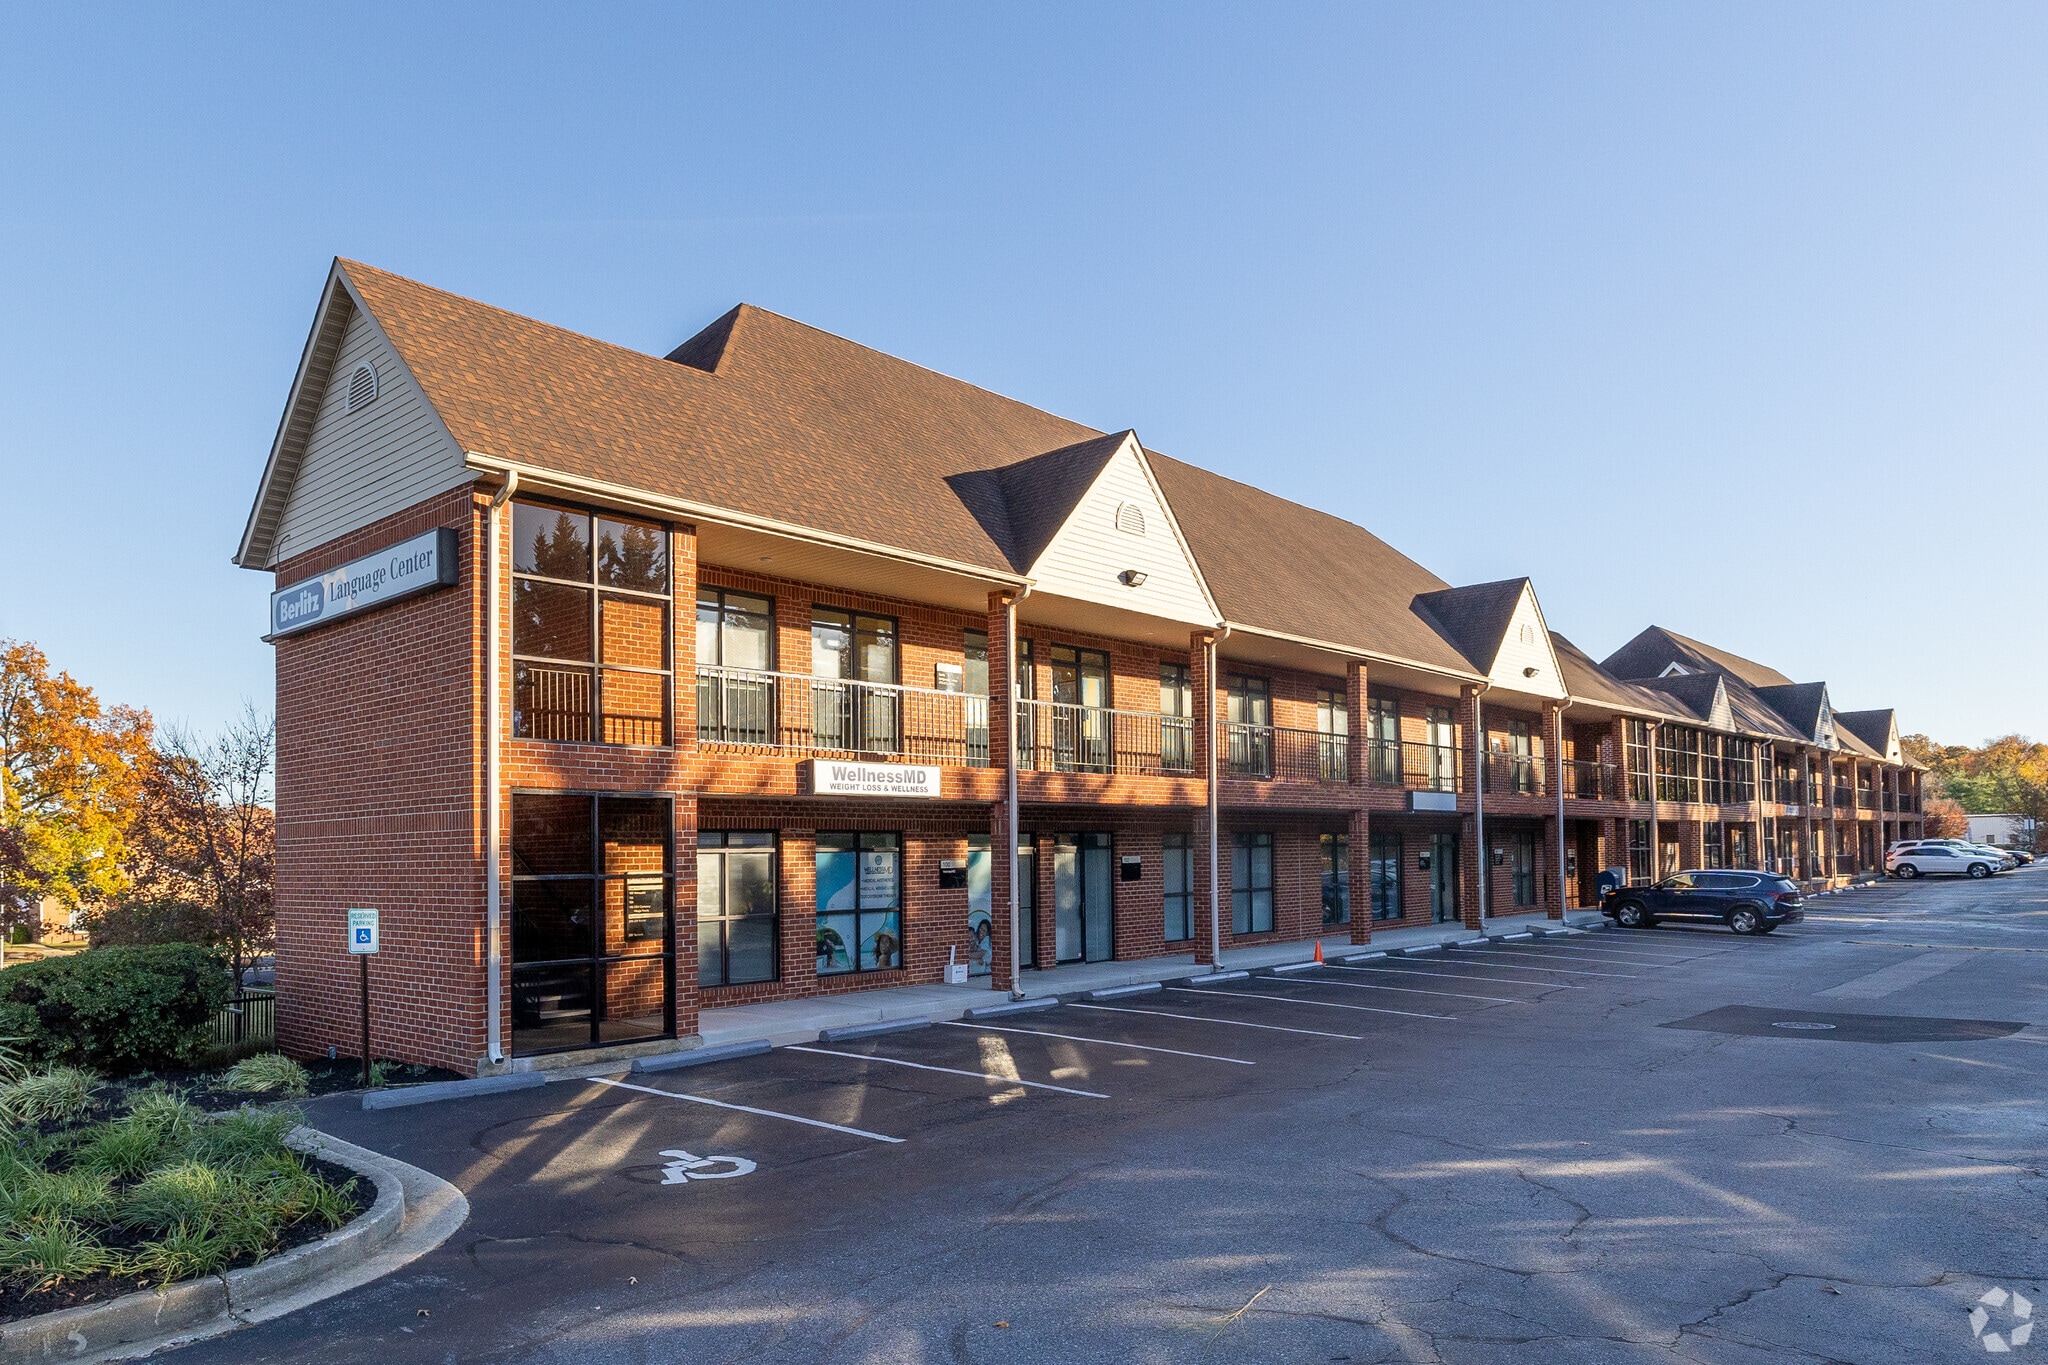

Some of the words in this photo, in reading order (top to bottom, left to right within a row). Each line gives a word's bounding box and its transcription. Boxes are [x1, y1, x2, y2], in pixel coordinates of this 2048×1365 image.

[280, 589, 320, 623] Berlitz
[330, 567, 387, 603] Language
[390, 549, 433, 580] Center
[831, 765, 927, 784] WellnessMD
[829, 783, 860, 791] WEIGHT
[862, 784, 882, 792] LOSS
[891, 785, 929, 793] WELLNESS
